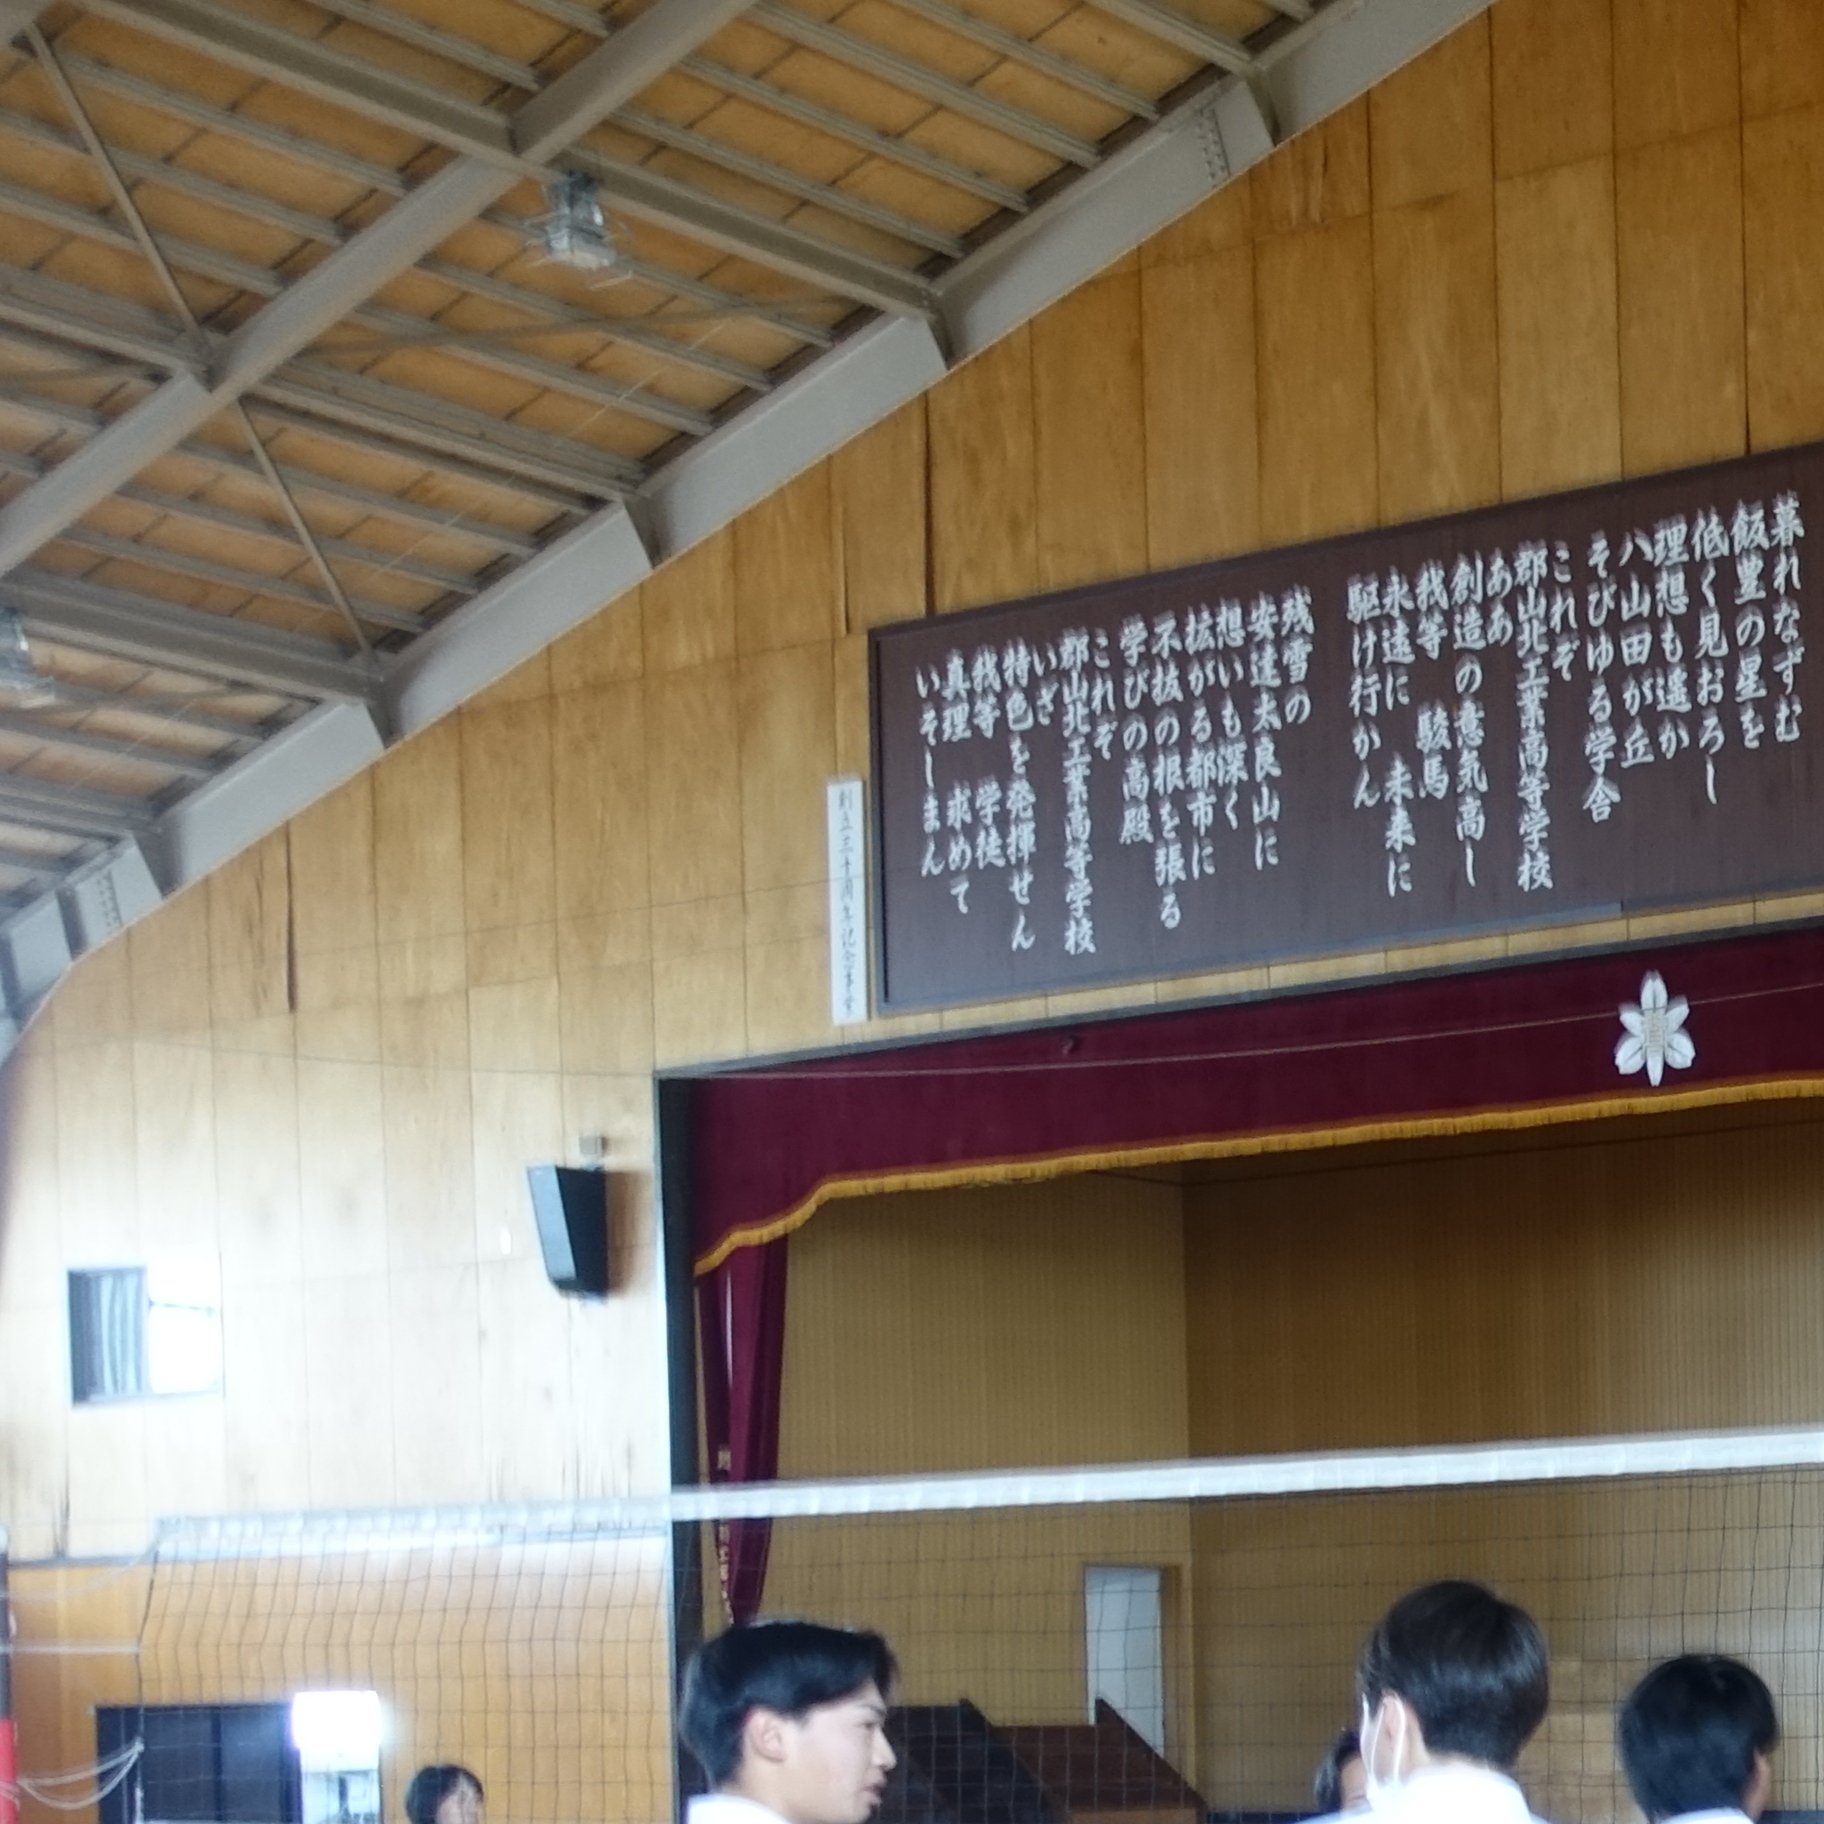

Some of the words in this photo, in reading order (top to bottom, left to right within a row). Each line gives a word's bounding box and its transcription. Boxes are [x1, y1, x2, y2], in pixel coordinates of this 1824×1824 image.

[1033, 643, 1059, 726] いざ
[1091, 629, 1117, 760] これぞ
[1216, 598, 1248, 829] 想いも深く
[1281, 585, 1315, 724] 残雪の
[1347, 573, 1381, 809] 駆け行かん
[1450, 551, 1488, 887] 創造の意気高し
[1486, 549, 1513, 647] ああ
[1514, 541, 1553, 891] 郡山北工業高等学校
[1550, 541, 1580, 681] これぞ
[1583, 531, 1620, 822] そびゆる学舎
[1619, 529, 1654, 768] 八山田が丘
[1692, 507, 1728, 804] 低く見おろし
[1731, 500, 1769, 749] 飯豊の星を
[1771, 491, 1804, 743] 暮れなずむ
[916, 666, 945, 877] いそしまん
[1003, 637, 1036, 951] 特色を発揮せん
[1059, 627, 1096, 955] 郡山北工業高等学校
[1120, 613, 1153, 844] 学びの高殿
[1151, 611, 1186, 928] 不抜の根を張る
[1248, 592, 1282, 870] 安達太良山に
